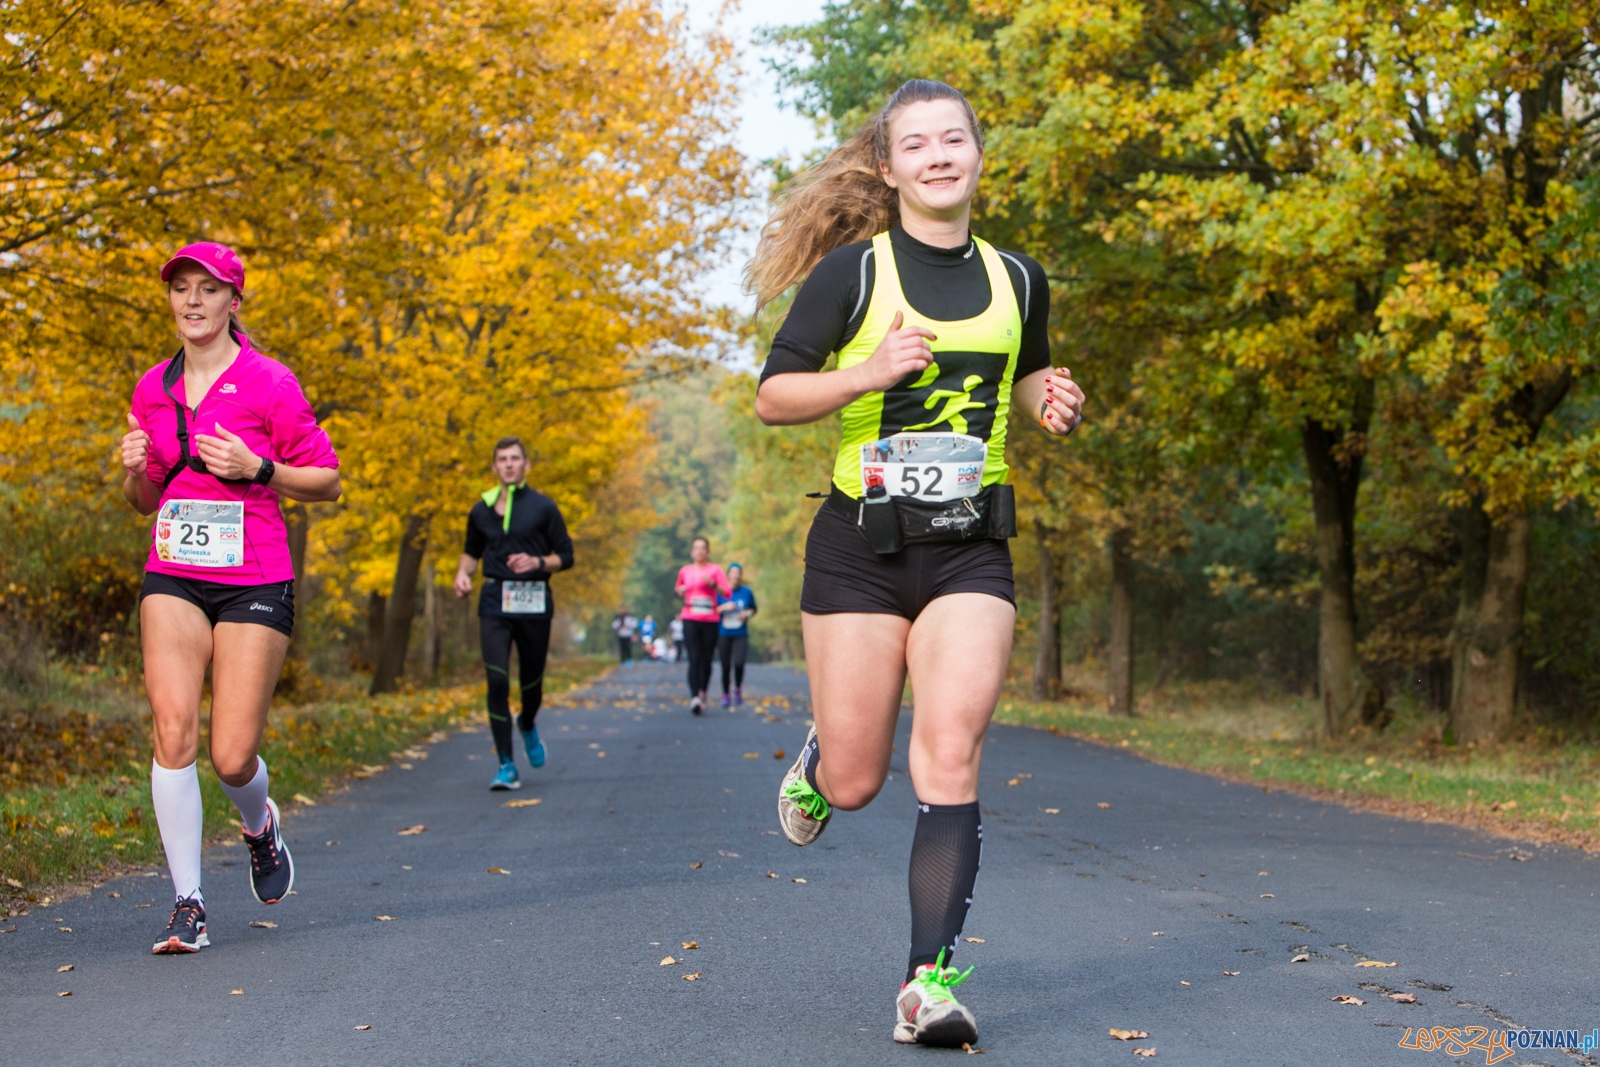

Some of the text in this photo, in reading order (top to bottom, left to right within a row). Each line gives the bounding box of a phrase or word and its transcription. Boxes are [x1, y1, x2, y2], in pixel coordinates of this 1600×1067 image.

[900, 466, 943, 497] 52
[180, 523, 210, 547] 25
[178, 547, 211, 556] Agnieszka
